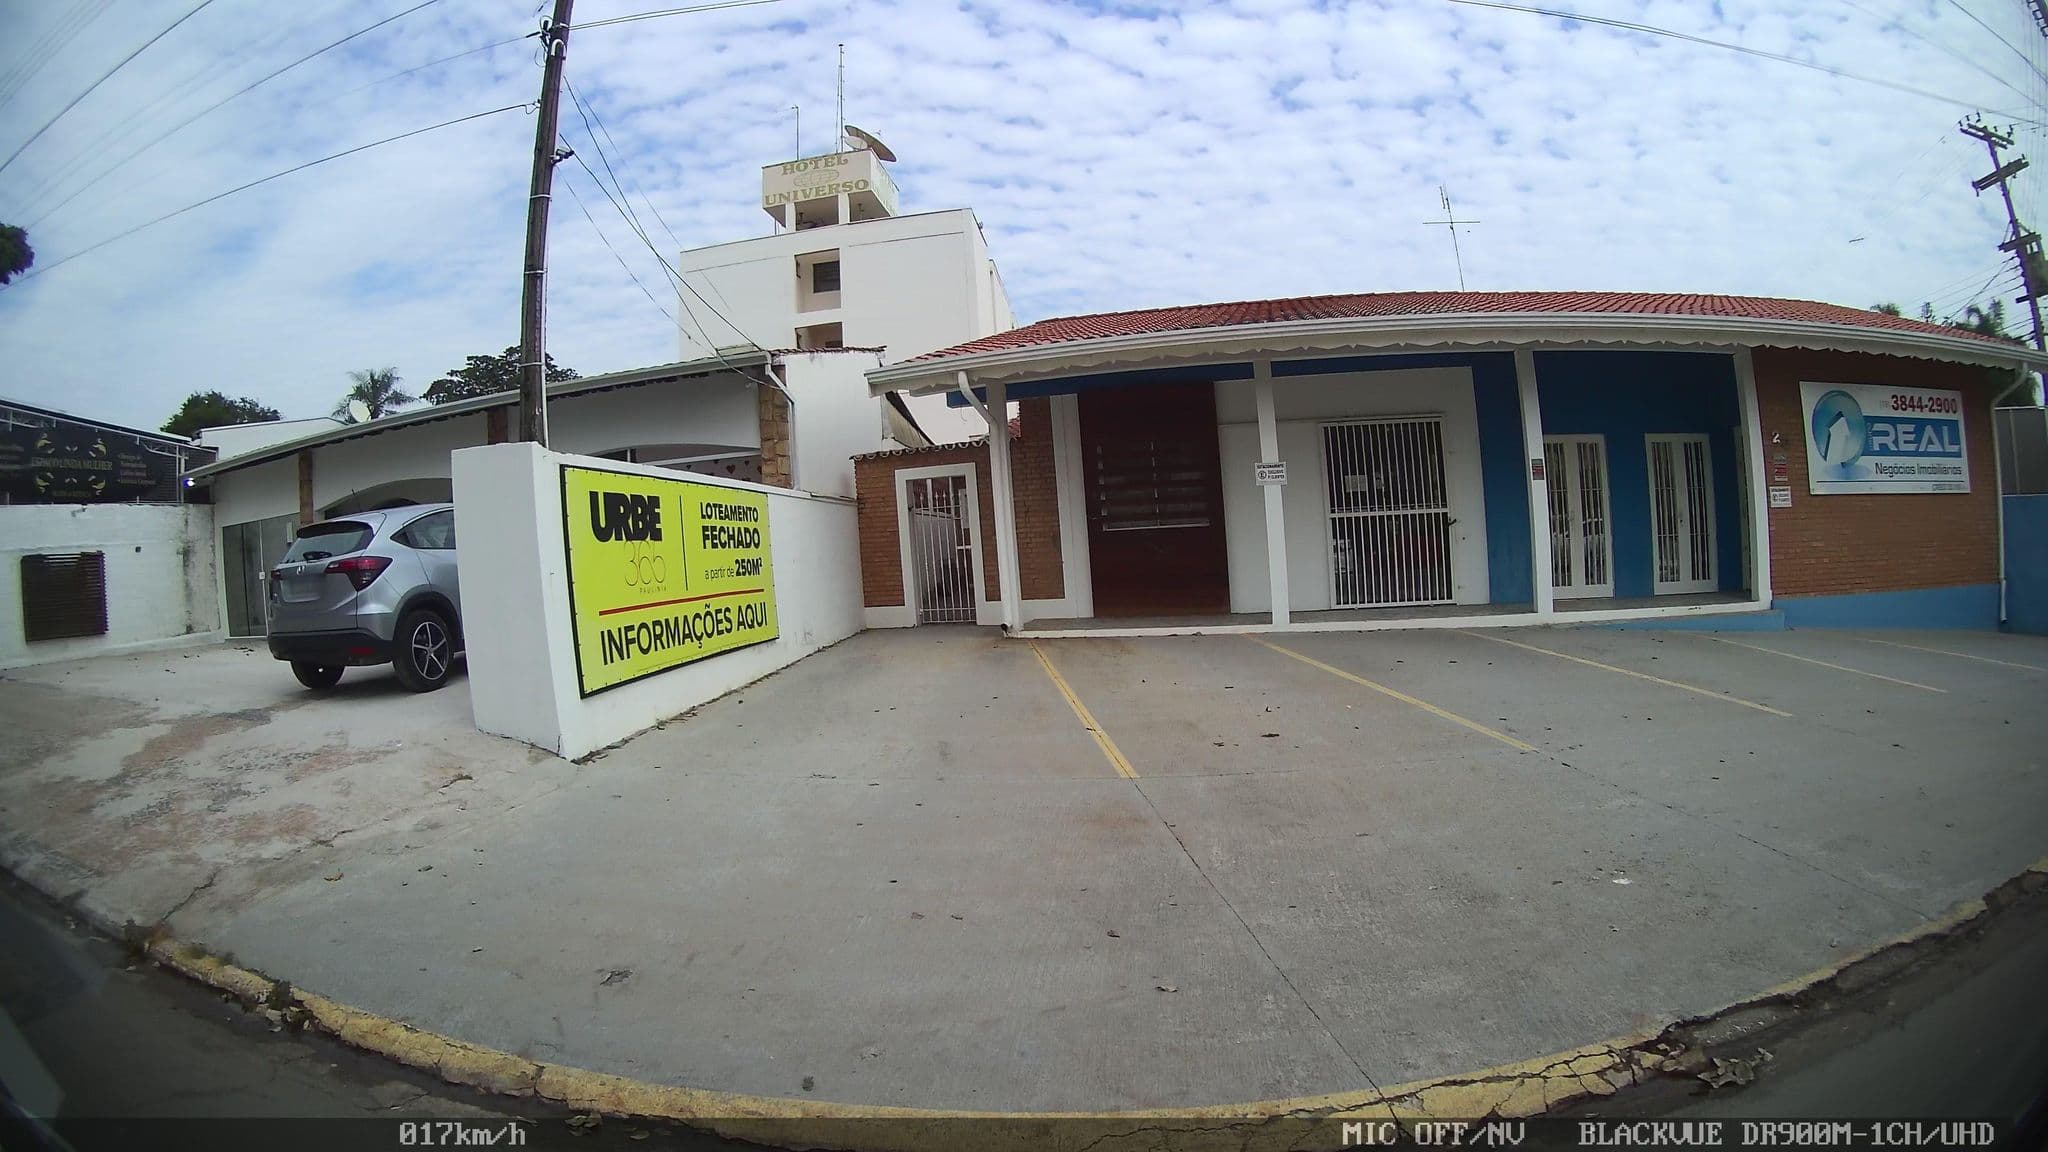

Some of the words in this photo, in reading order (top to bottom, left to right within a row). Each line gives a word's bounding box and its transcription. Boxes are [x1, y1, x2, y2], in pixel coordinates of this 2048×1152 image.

[782, 154, 848, 175] HOTEL
[765, 179, 869, 206] UNIVERSO
[1891, 394, 1958, 414] 3844-2900
[1872, 423, 1960, 452] REAL
[589, 490, 663, 542] URBE
[700, 502, 759, 522] LOTEAMENTO
[702, 525, 760, 549] FECHADO
[705, 570, 709, 579] a
[710, 567, 726, 580] partir
[727, 566, 734, 577] de
[600, 603, 733, 665] INFORMAÇÕES
[737, 602, 768, 631] AQUI
